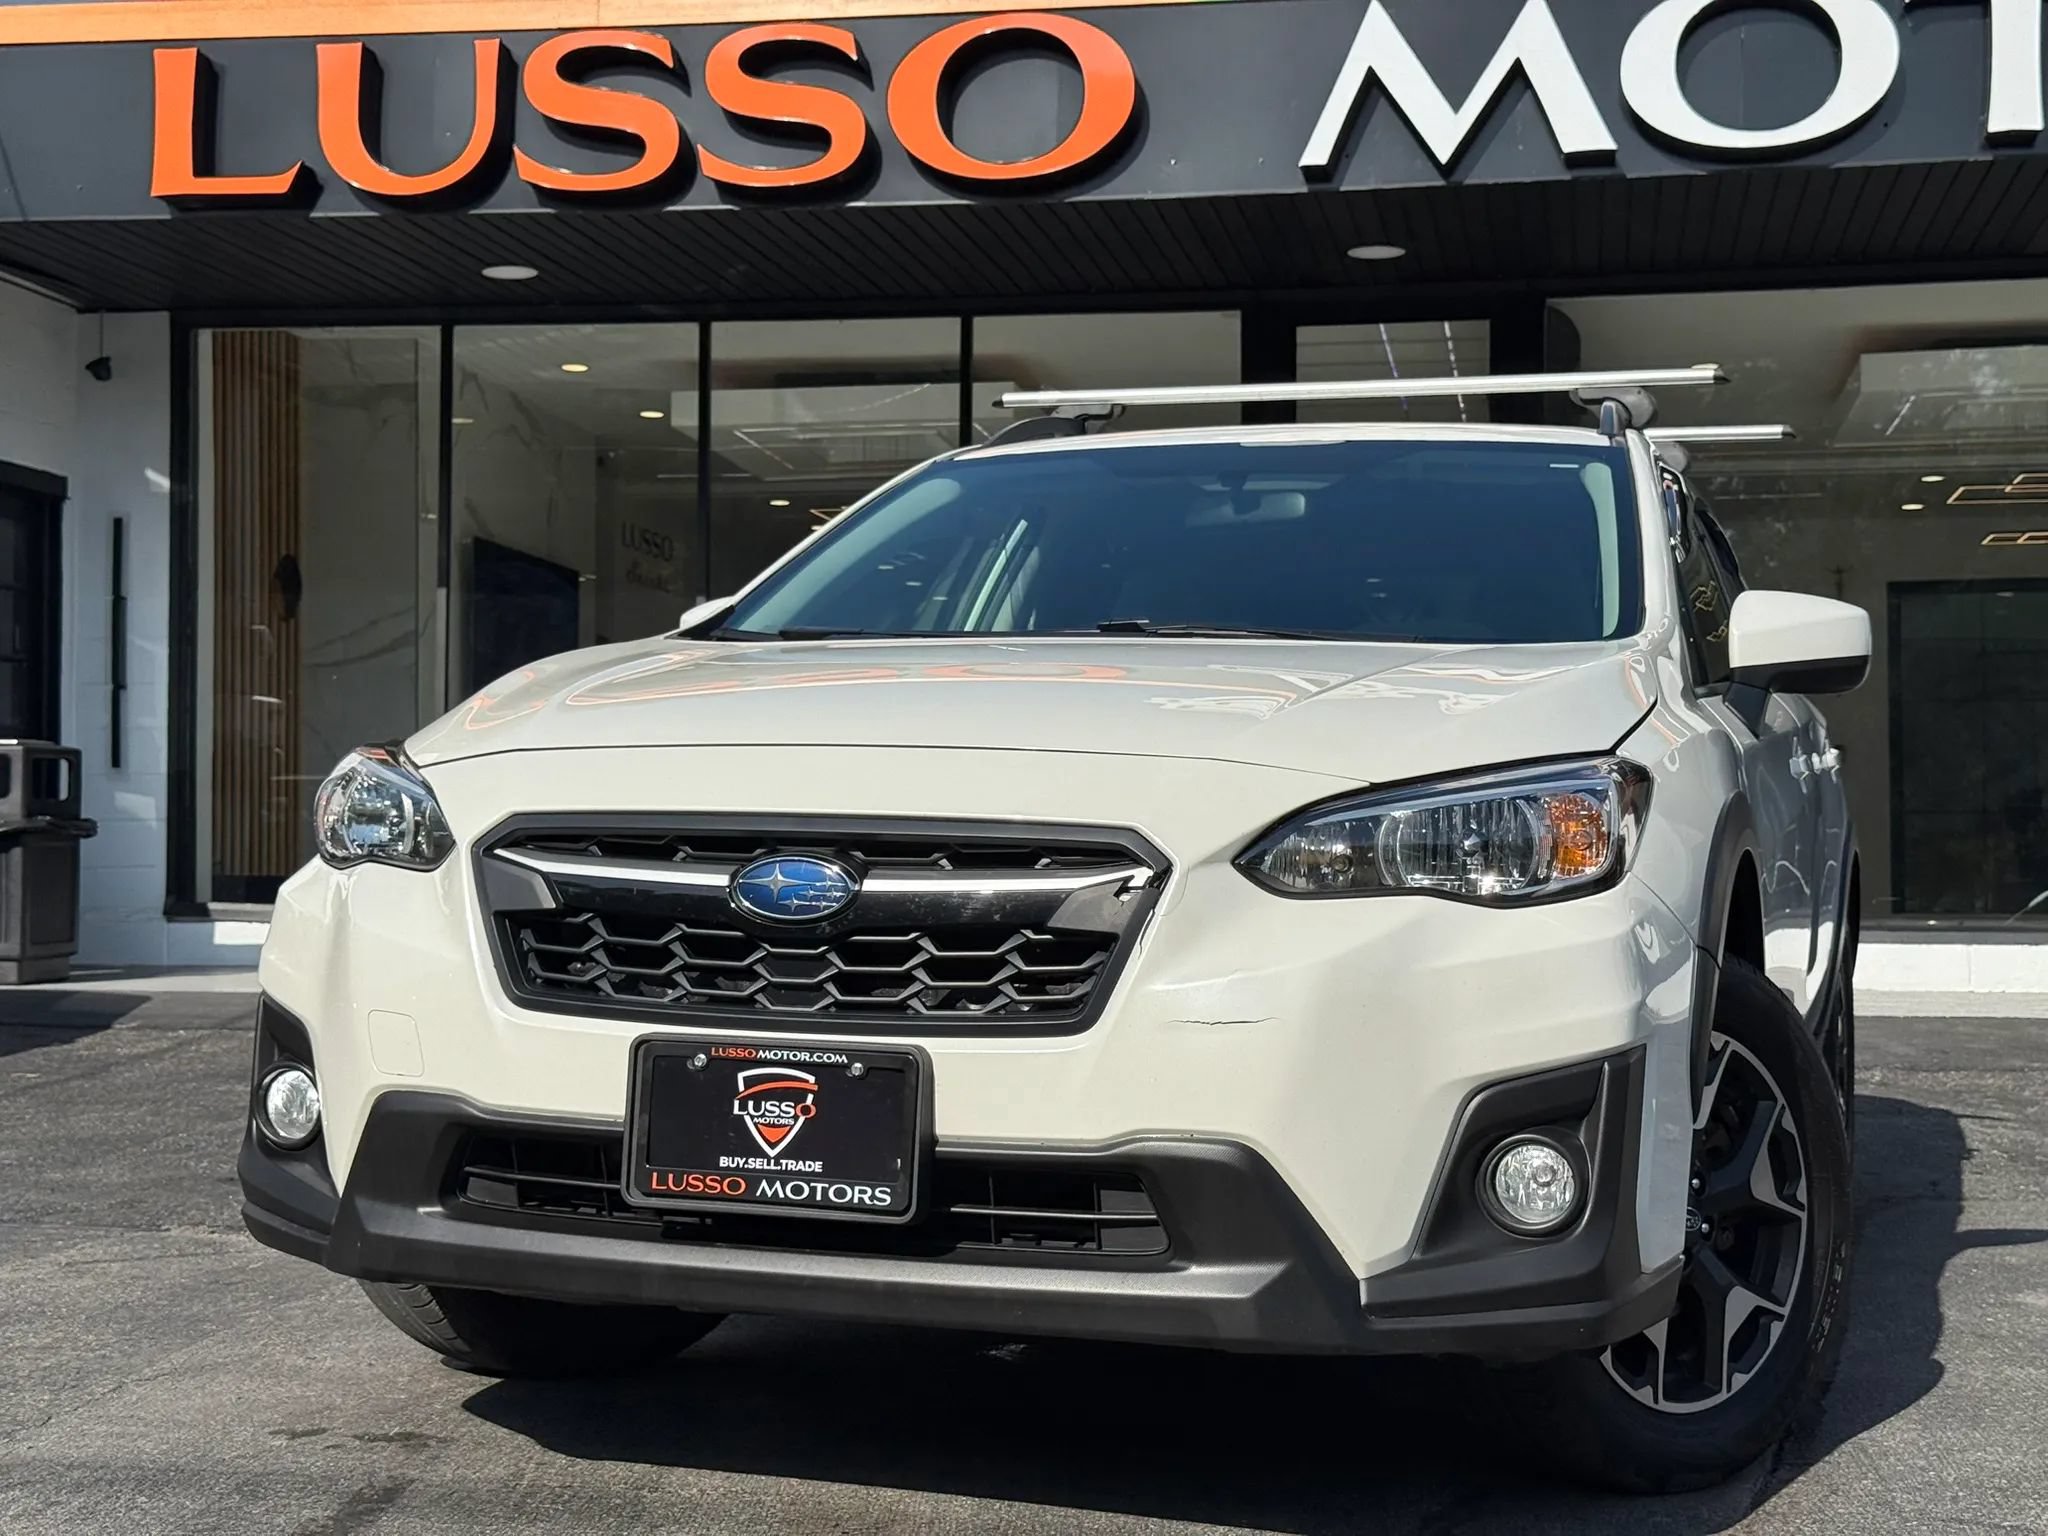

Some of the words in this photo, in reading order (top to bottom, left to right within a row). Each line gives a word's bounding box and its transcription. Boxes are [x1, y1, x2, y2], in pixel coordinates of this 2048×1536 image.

[150, 12, 1136, 198] LUSSO
[733, 1099, 817, 1119] LUSSO
[753, 1116, 795, 1126] MOTORS
[719, 1156, 823, 1173] BUY.SELL.TRADE
[651, 1171, 747, 1196] LUSSO
[755, 1178, 892, 1206] MOTORS
